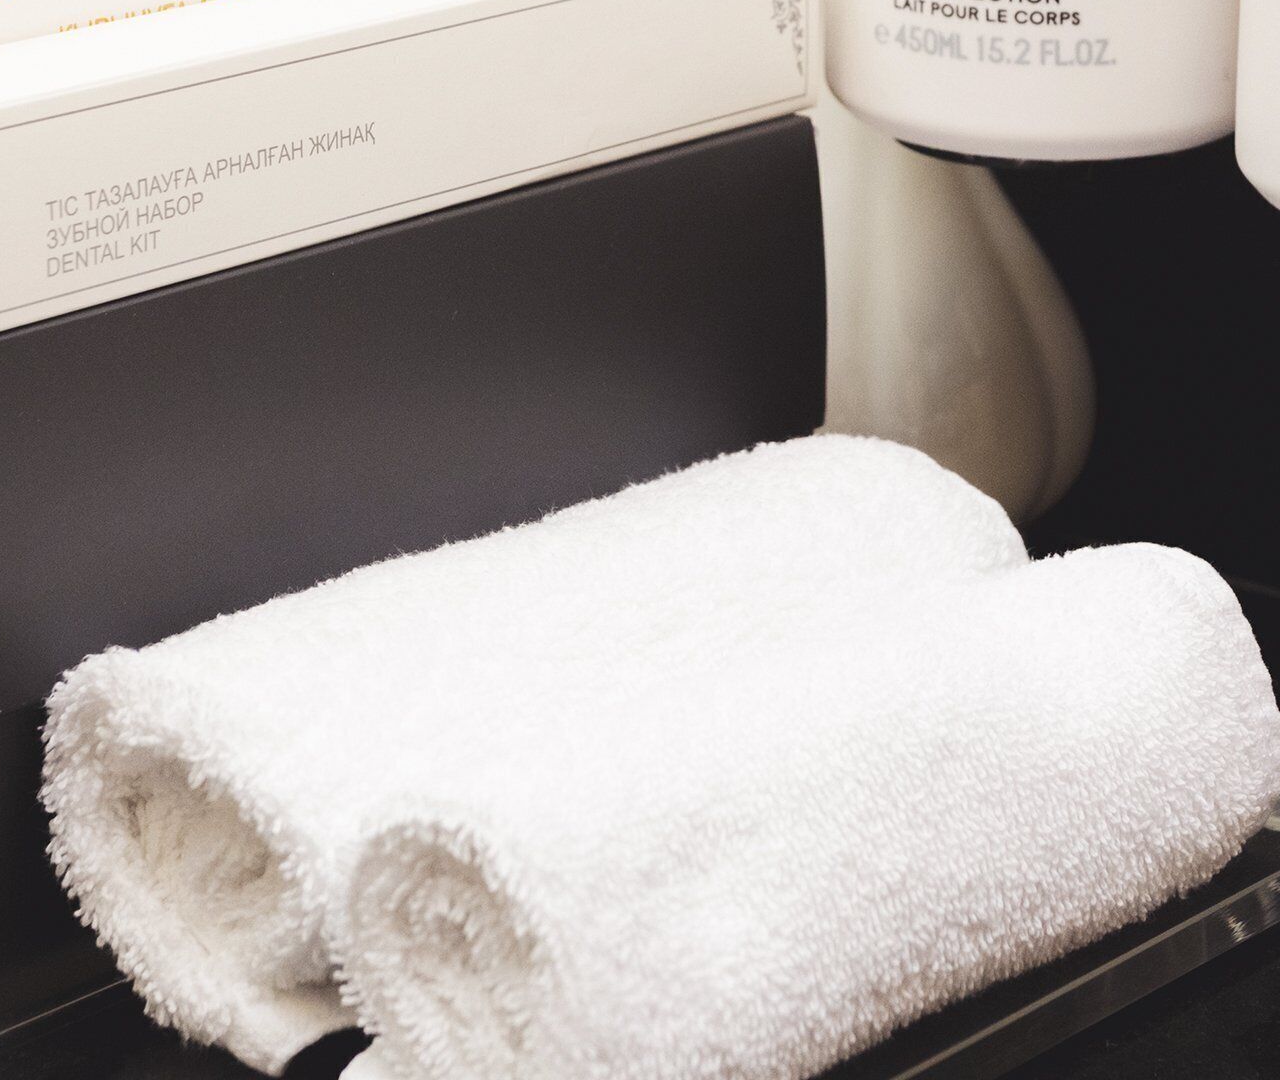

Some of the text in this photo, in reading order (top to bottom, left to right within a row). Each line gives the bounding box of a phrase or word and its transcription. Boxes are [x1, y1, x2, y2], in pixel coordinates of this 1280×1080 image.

[930, 1, 980, 22] POUR
[985, 8, 1008, 24] LE
[1014, 10, 1081, 26] CORPS
[894, 24, 968, 62] 450ML
[977, 34, 1032, 66] 15.2
[1040, 38, 1117, 67] FL.OZ.
[84, 167, 198, 211] ТАЗАЛАУҒА
[202, 139, 304, 183] АРНАЛҒАН
[308, 121, 376, 157] ЖИНАҚ
[46, 191, 205, 250] ЗУБНОЙ НАБОР
[46, 230, 162, 278] DENTAL KIT
